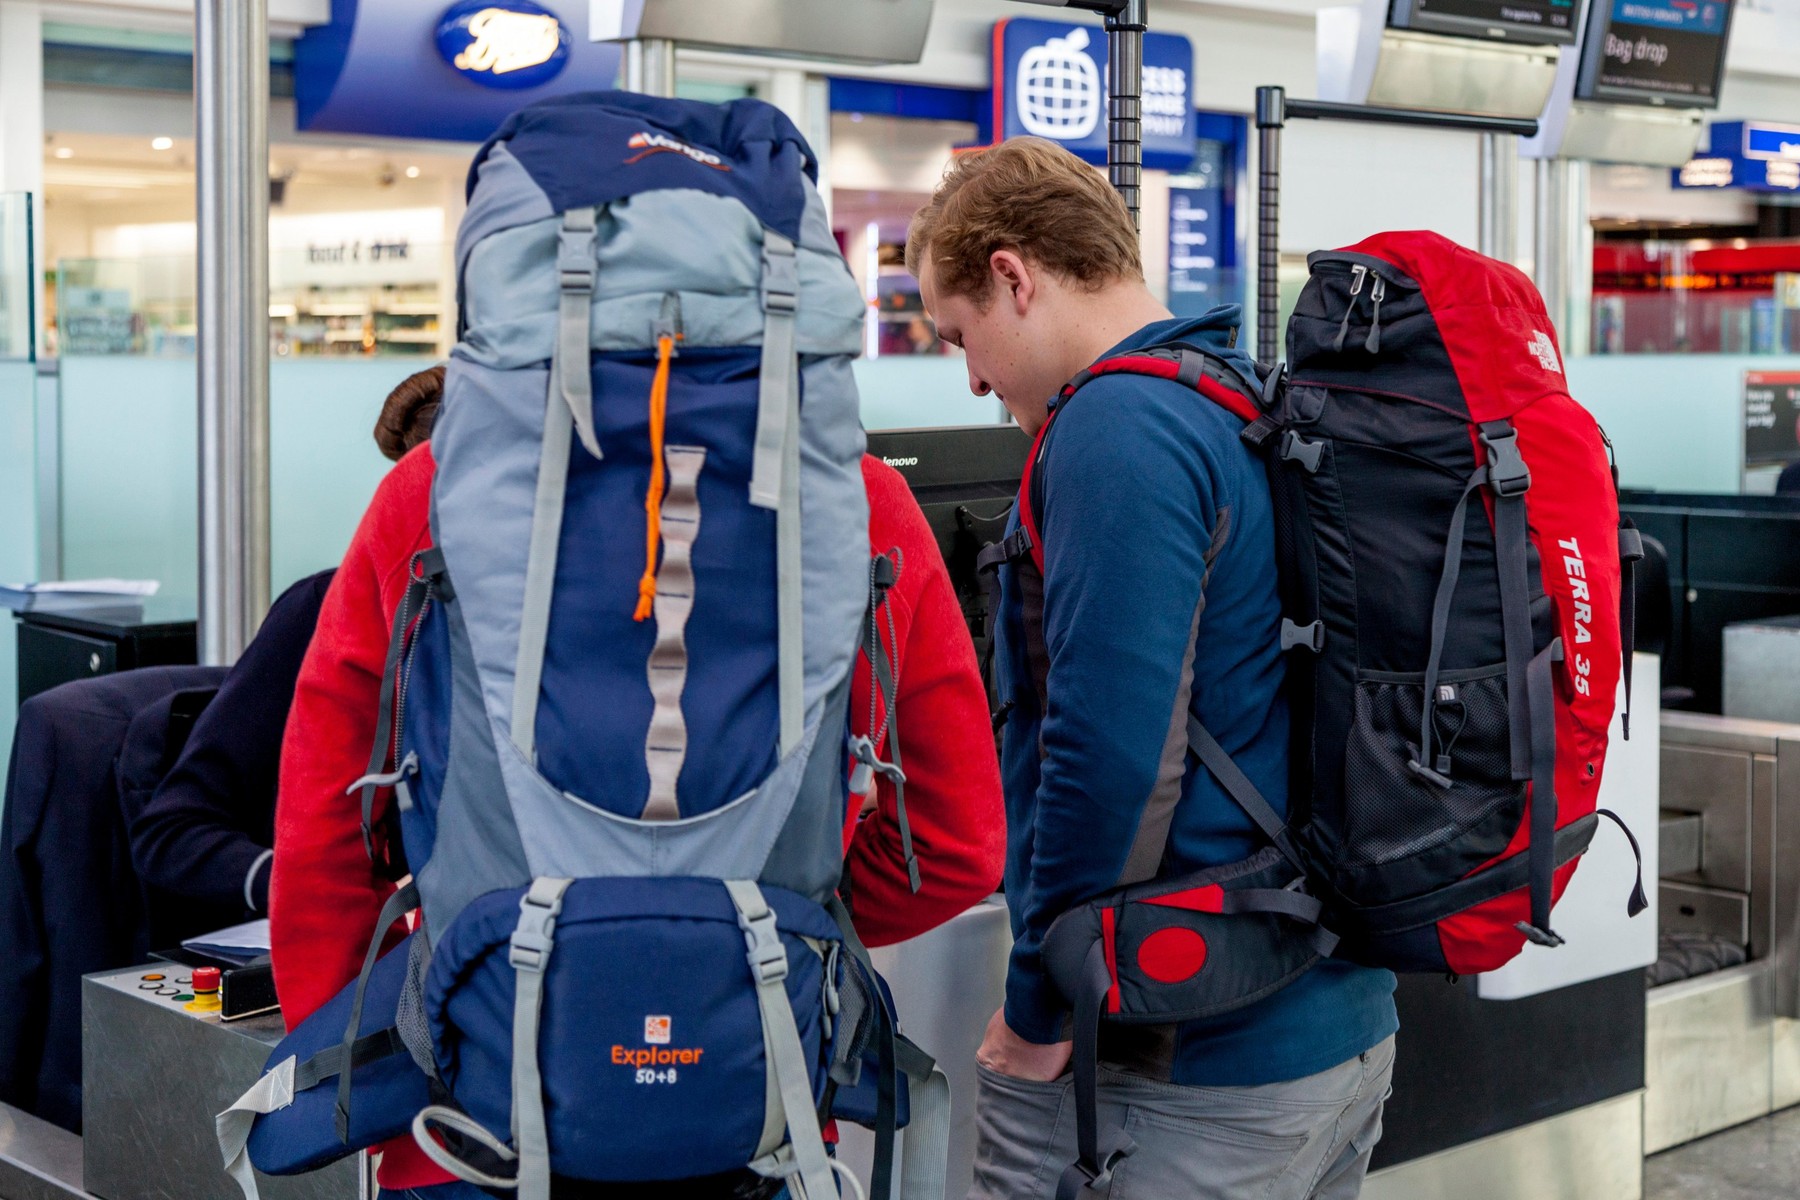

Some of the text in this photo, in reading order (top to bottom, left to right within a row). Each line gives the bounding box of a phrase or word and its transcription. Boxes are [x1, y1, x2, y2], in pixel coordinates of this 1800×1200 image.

[1604, 32, 1668, 67] Bag drop
[1558, 537, 1592, 697] TERRA 35
[611, 1044, 704, 1069] Explorer
[635, 1067, 677, 1084] 50+8
